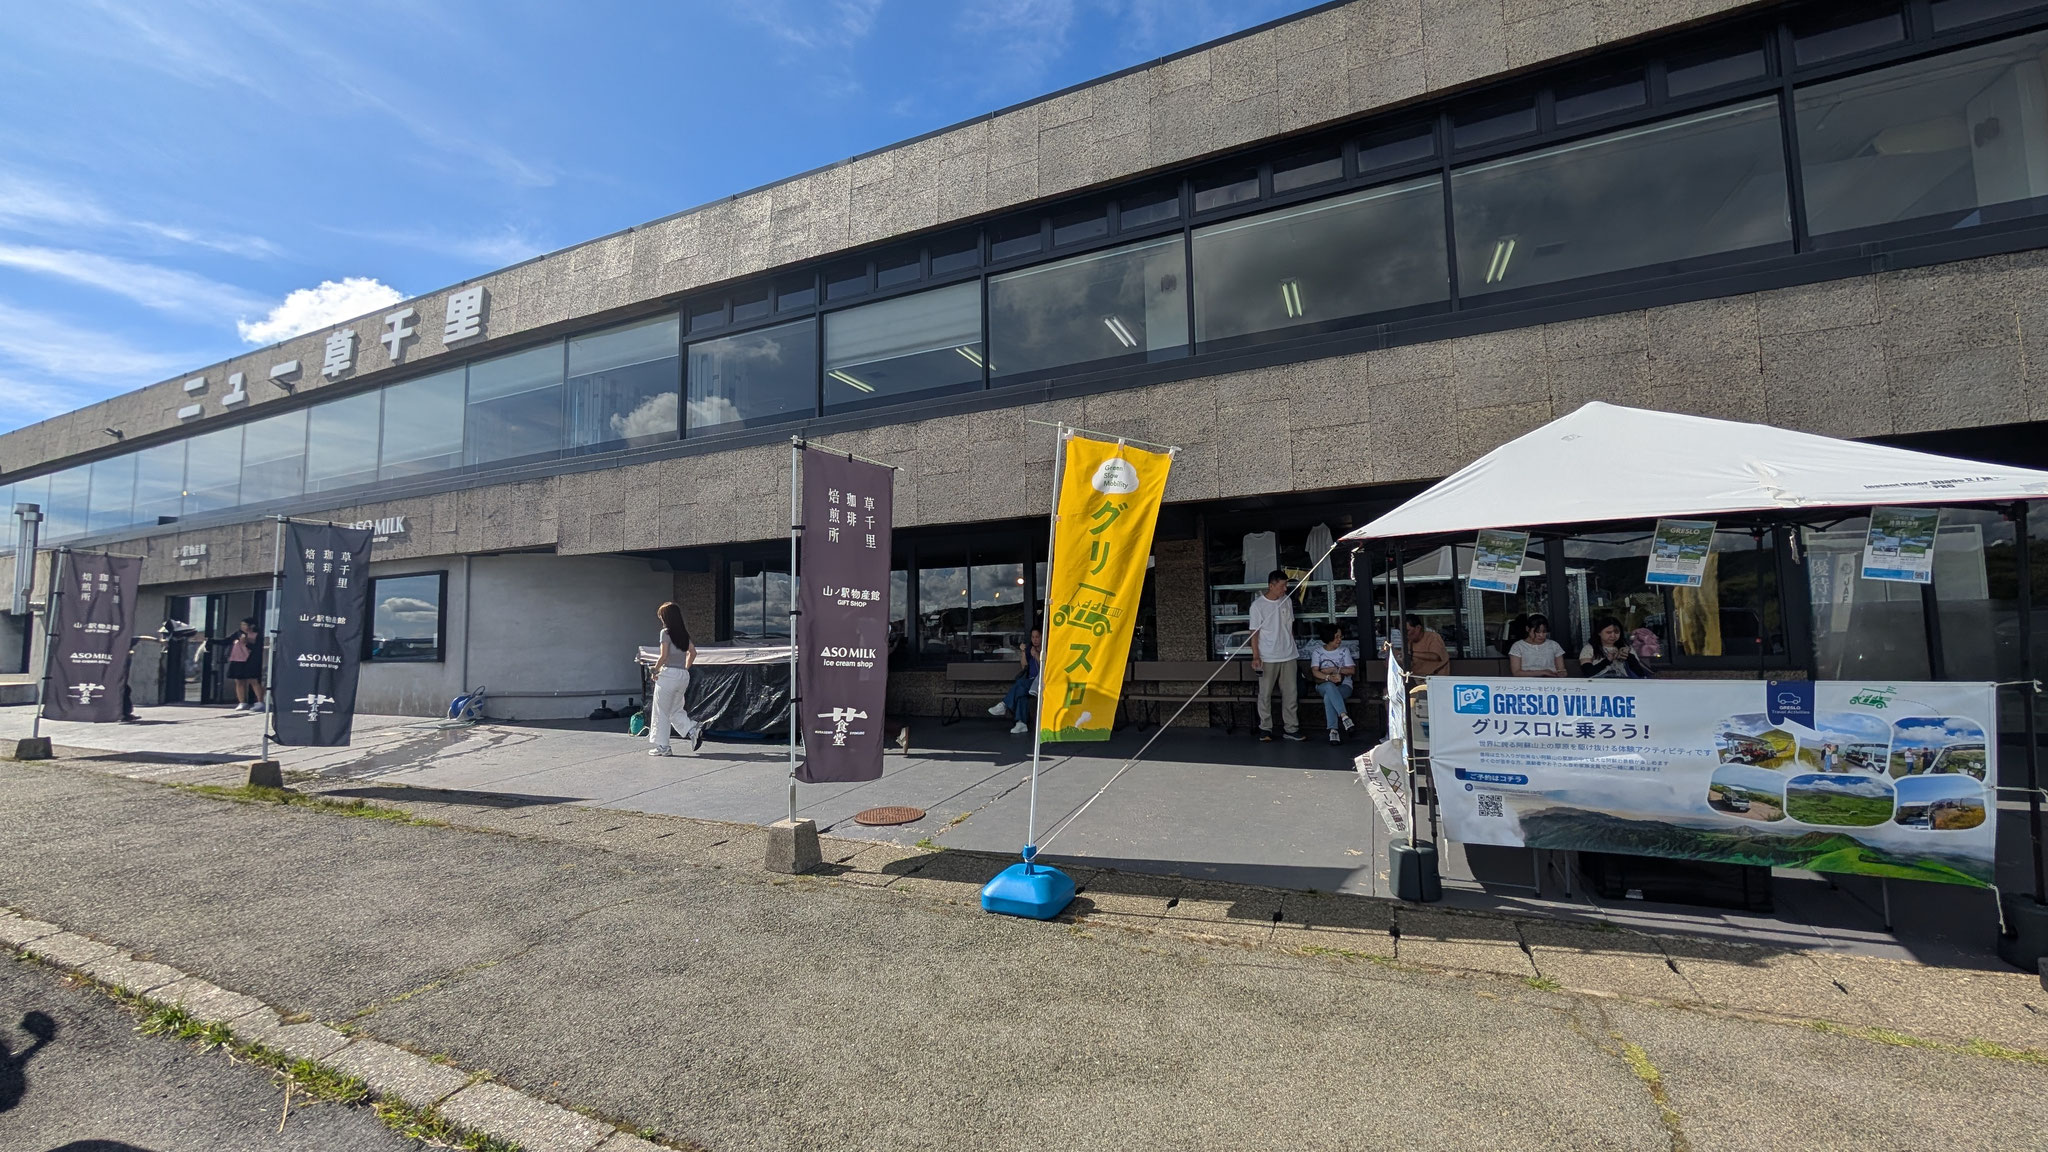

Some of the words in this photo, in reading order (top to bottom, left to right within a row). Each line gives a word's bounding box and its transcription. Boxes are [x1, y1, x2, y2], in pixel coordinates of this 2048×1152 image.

[178, 286, 485, 419] ニュー草千里
[1103, 480, 1129, 490] Mobility
[828, 488, 840, 543] 焙煎所
[846, 492, 857, 527] 珈琲
[374, 515, 407, 536] MILK
[864, 496, 877, 549] 草千里
[1670, 527, 1700, 535] GRESLO
[305, 548, 316, 587] 焙煎所
[322, 550, 334, 573] 珈琲
[336, 551, 352, 589] 草千里
[822, 585, 880, 601] 山ノ駅物産館
[837, 599, 850, 607] GIFT
[850, 600, 867, 608] SHOP
[92, 652, 113, 661] MILK
[296, 653, 321, 662] ASO
[321, 655, 342, 664] MILK
[820, 646, 848, 658] ASO
[849, 647, 877, 659] MILK
[857, 660, 874, 669] shop
[1464, 691, 1479, 702] GV
[1493, 692, 1560, 717] GRESLO
[1563, 695, 1636, 719] VILLAGE
[1470, 773, 1522, 783] ご予約はコチラ
